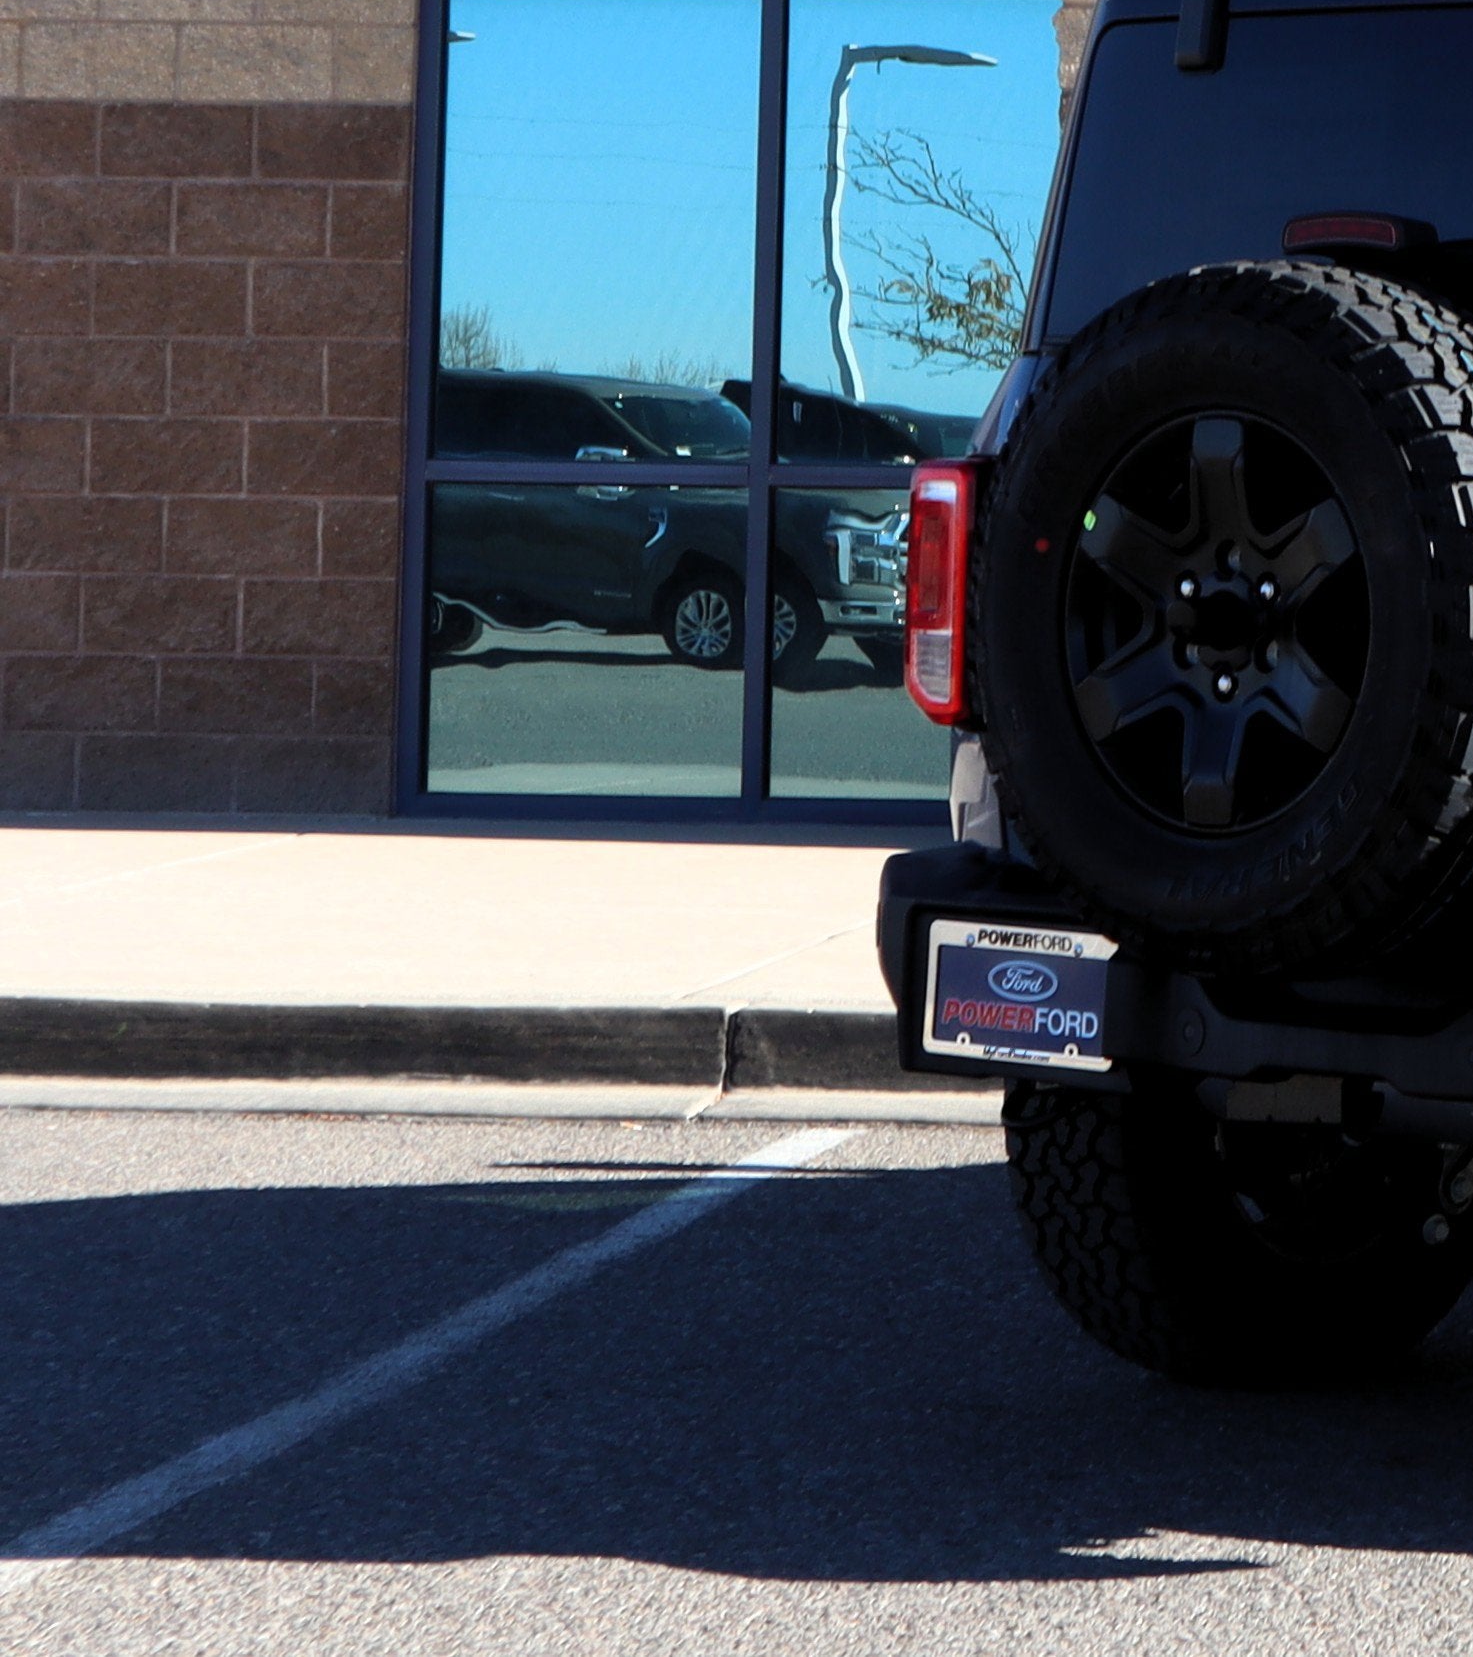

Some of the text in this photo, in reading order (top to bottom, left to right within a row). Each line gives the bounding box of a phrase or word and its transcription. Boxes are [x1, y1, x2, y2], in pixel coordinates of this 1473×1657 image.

[978, 928, 1072, 952] POWERFORD
[1001, 967, 1044, 993] Ford
[943, 999, 1098, 1038] POWERFORD
